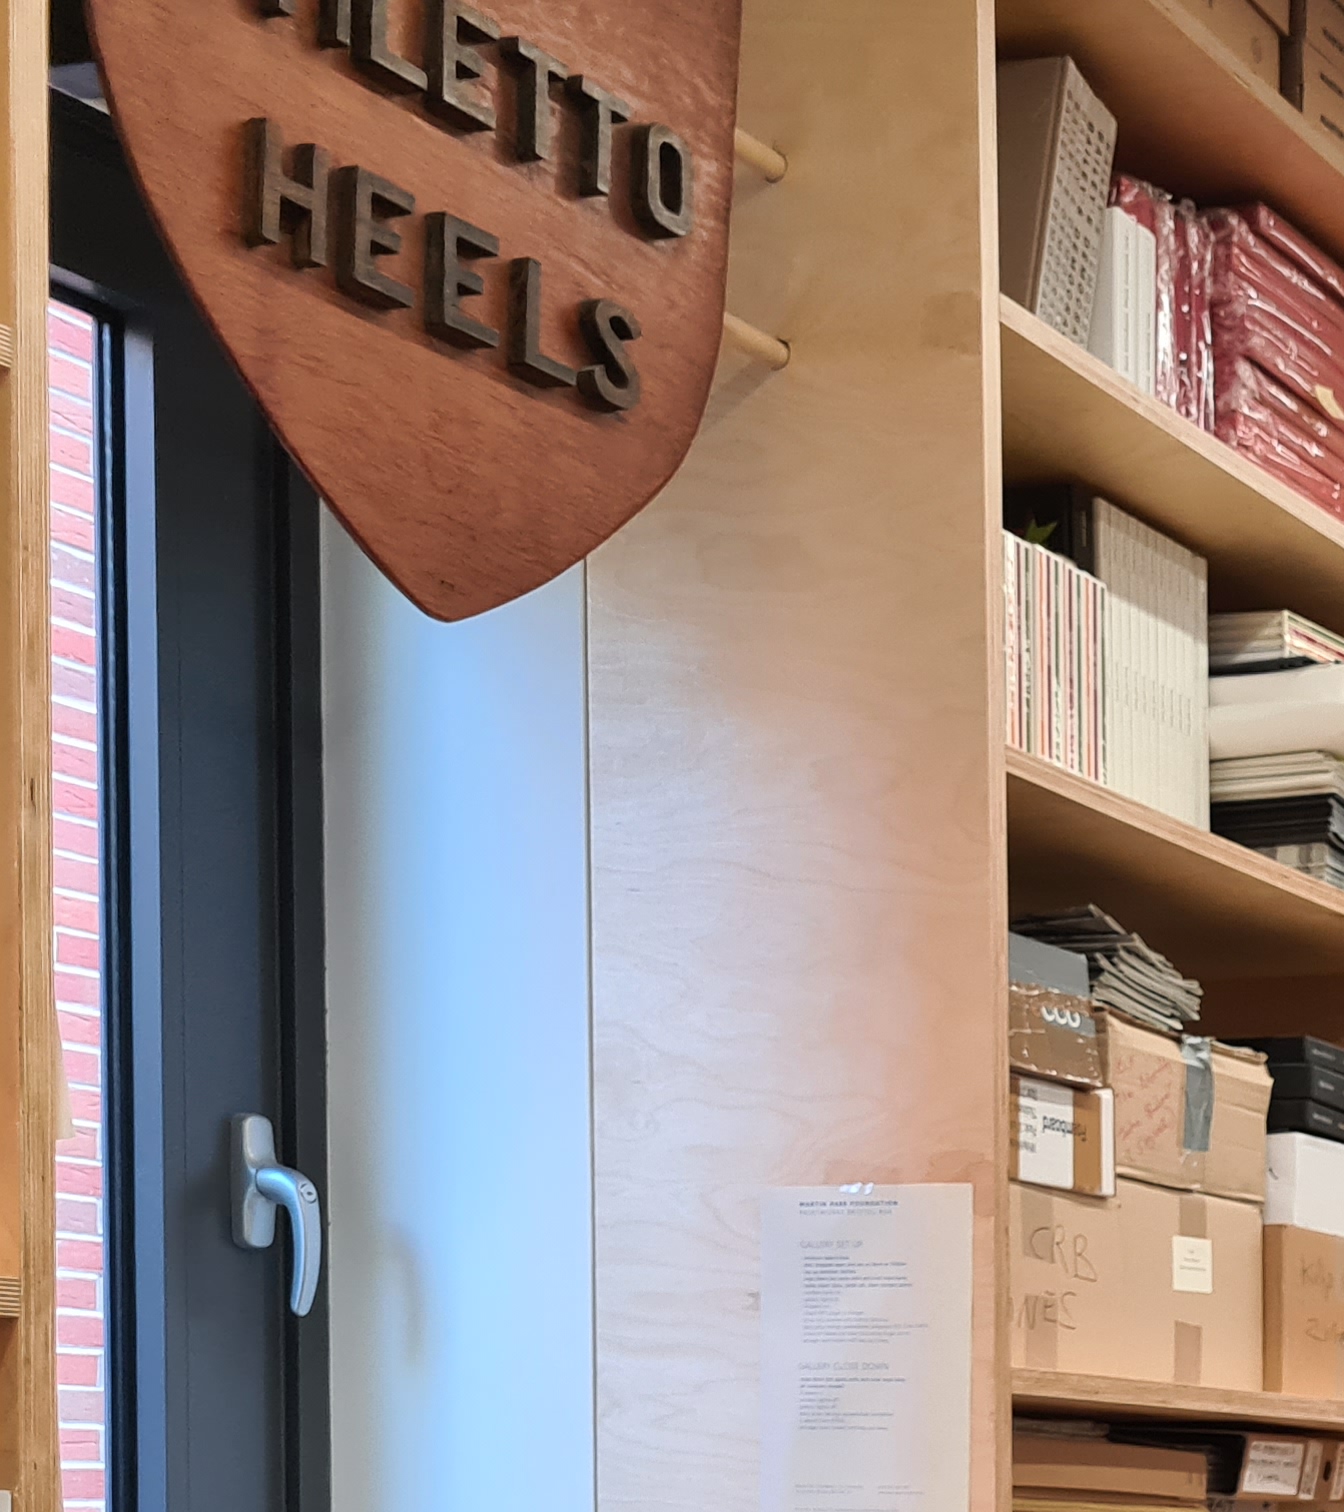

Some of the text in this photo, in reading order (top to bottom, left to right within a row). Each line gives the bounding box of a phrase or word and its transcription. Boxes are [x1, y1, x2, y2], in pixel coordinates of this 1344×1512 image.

[262, 0, 693, 238] LETTO
[245, 118, 642, 412] HEELS
[1029, 1225, 1097, 1282] CRB
